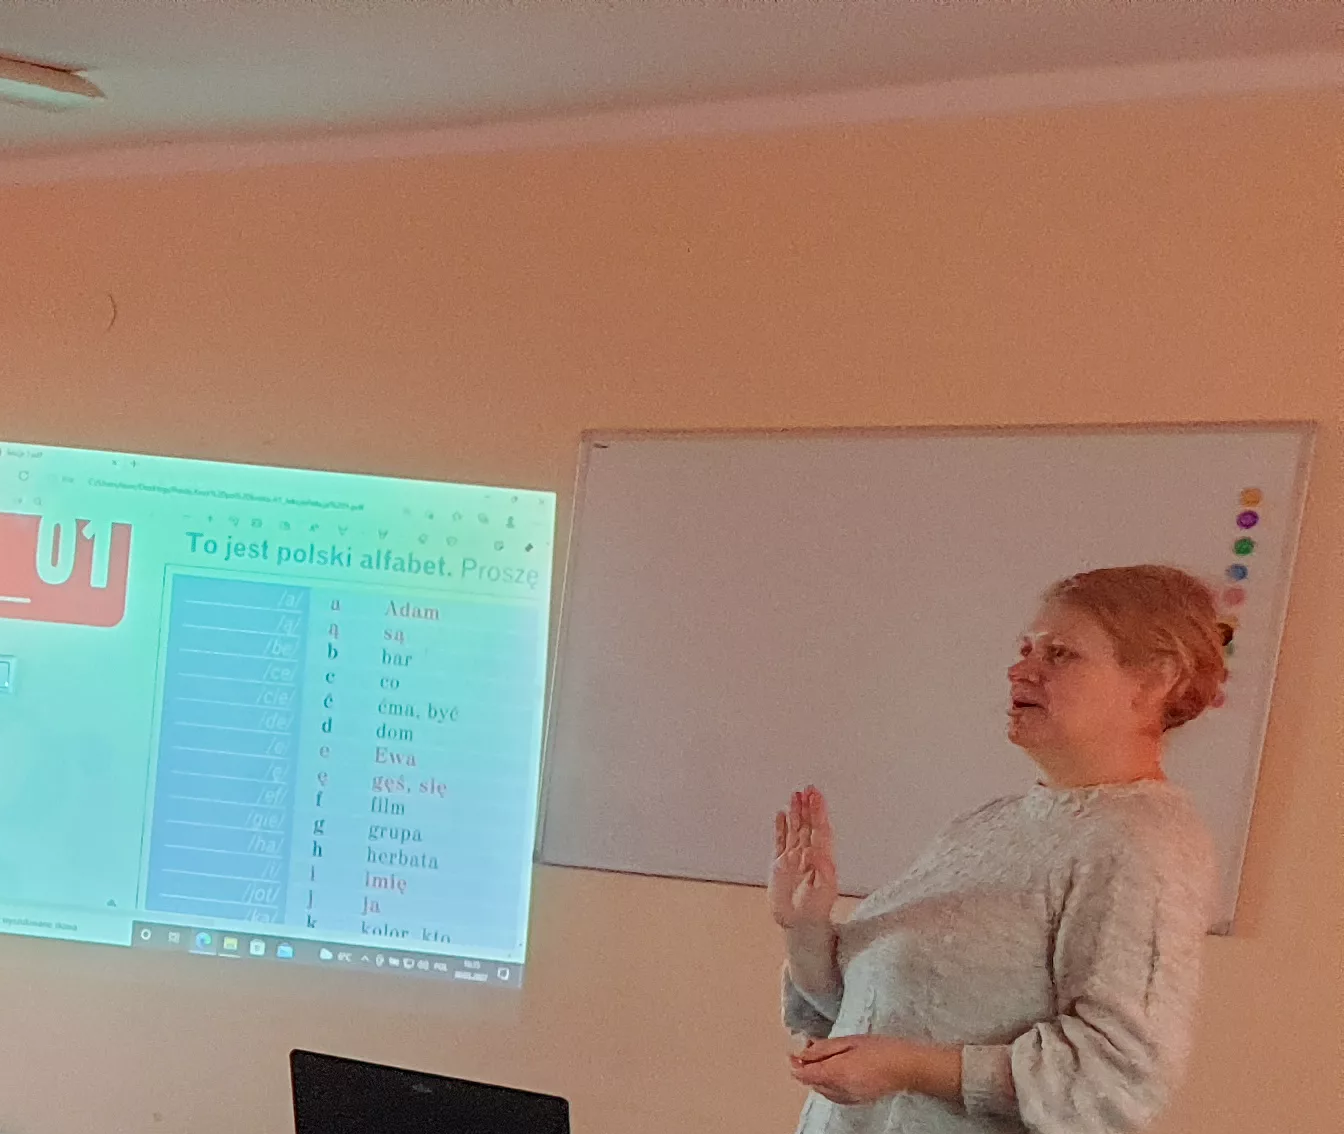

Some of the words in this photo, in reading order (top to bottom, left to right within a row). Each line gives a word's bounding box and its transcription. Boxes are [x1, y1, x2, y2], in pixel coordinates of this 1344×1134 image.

[36, 515, 112, 588] 01
[185, 531, 217, 554] To
[224, 535, 268, 561] jest
[277, 543, 351, 567] polski
[359, 550, 452, 577] alfabet.
[462, 557, 539, 589] Proszę
[384, 599, 440, 621] Adam
[383, 628, 404, 644] są
[327, 642, 338, 660] b
[382, 648, 412, 667] bar
[325, 671, 335, 684] c
[380, 676, 400, 690] co
[378, 698, 420, 719] ćma,
[427, 703, 459, 723] być
[321, 716, 332, 733] d
[376, 723, 413, 742] dom
[319, 745, 330, 758] e
[375, 746, 416, 767] Ewa
[315, 790, 323, 807] f
[370, 796, 405, 815] film
[313, 818, 325, 836] g
[368, 824, 423, 844] grupa
[312, 840, 322, 857] h
[366, 846, 439, 869] herbata
[361, 896, 381, 915] ja
[307, 914, 317, 928] k
